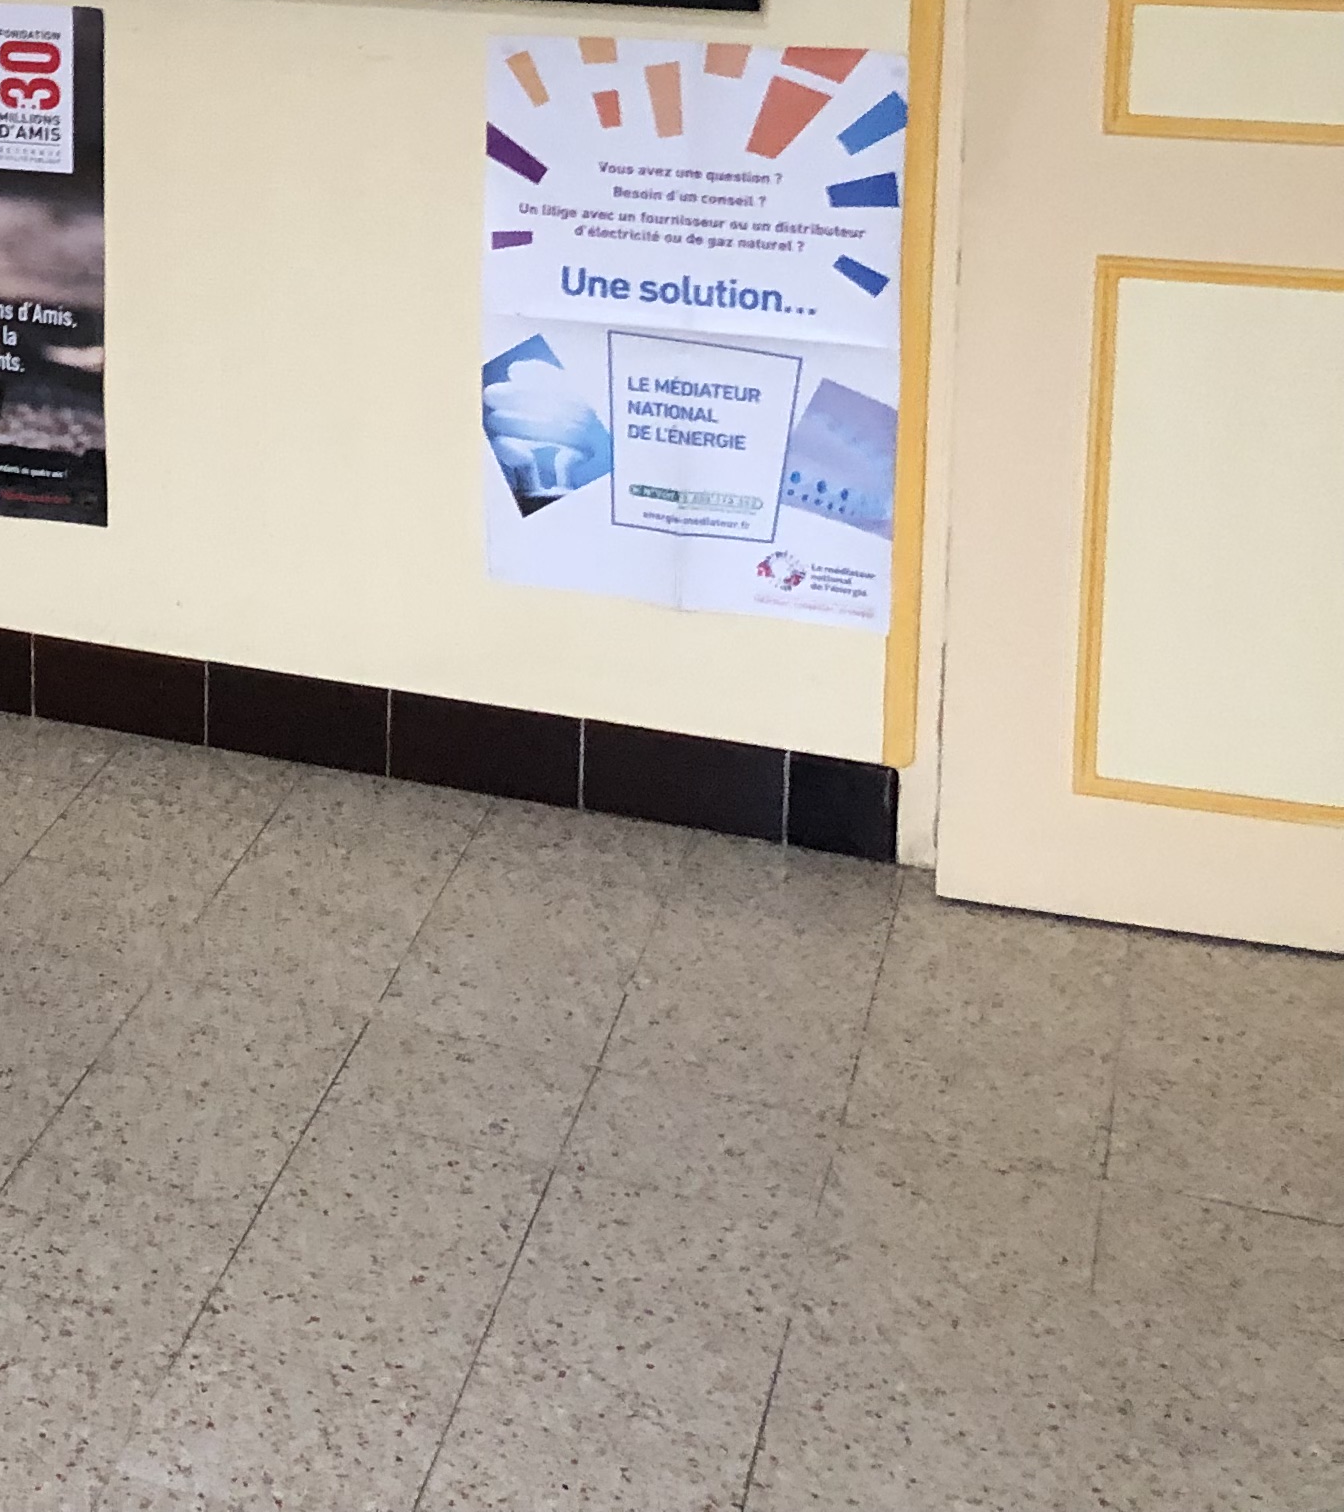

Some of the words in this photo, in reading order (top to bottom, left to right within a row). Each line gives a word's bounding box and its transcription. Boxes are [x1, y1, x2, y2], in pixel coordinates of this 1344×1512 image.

[0, 40, 61, 110] 30
[598, 160, 634, 176] Vous
[637, 166, 672, 178] avez
[675, 168, 703, 180] une
[706, 170, 770, 185] question
[774, 173, 784, 185] ?
[613, 186, 663, 201] Besoin
[666, 189, 698, 203] d'un
[700, 194, 755, 207] conseil
[758, 195, 767, 207] ?
[518, 201, 538, 215] Un
[541, 203, 577, 220] litige
[581, 209, 615, 222] avec
[618, 211, 636, 223] un
[640, 211, 725, 229] fournisseur
[729, 219, 748, 230] ou
[752, 220, 771, 232] un
[775, 220, 866, 240] distributeur
[574, 224, 660, 243] d'électricité
[663, 232, 682, 244] ou
[685, 231, 704, 245] de
[707, 237, 734, 249] gaz
[737, 237, 794, 253] naturel
[796, 240, 806, 253] ?
[560, 265, 631, 301] Une
[639, 272, 818, 316] solution...
[2, 324, 18, 347] la
[627, 375, 650, 393] LE
[654, 375, 762, 404] MÉDIATEUR
[627, 399, 720, 424] NATIONAL
[627, 423, 652, 441] DE
[655, 424, 747, 451] L'ÉNERGIE
